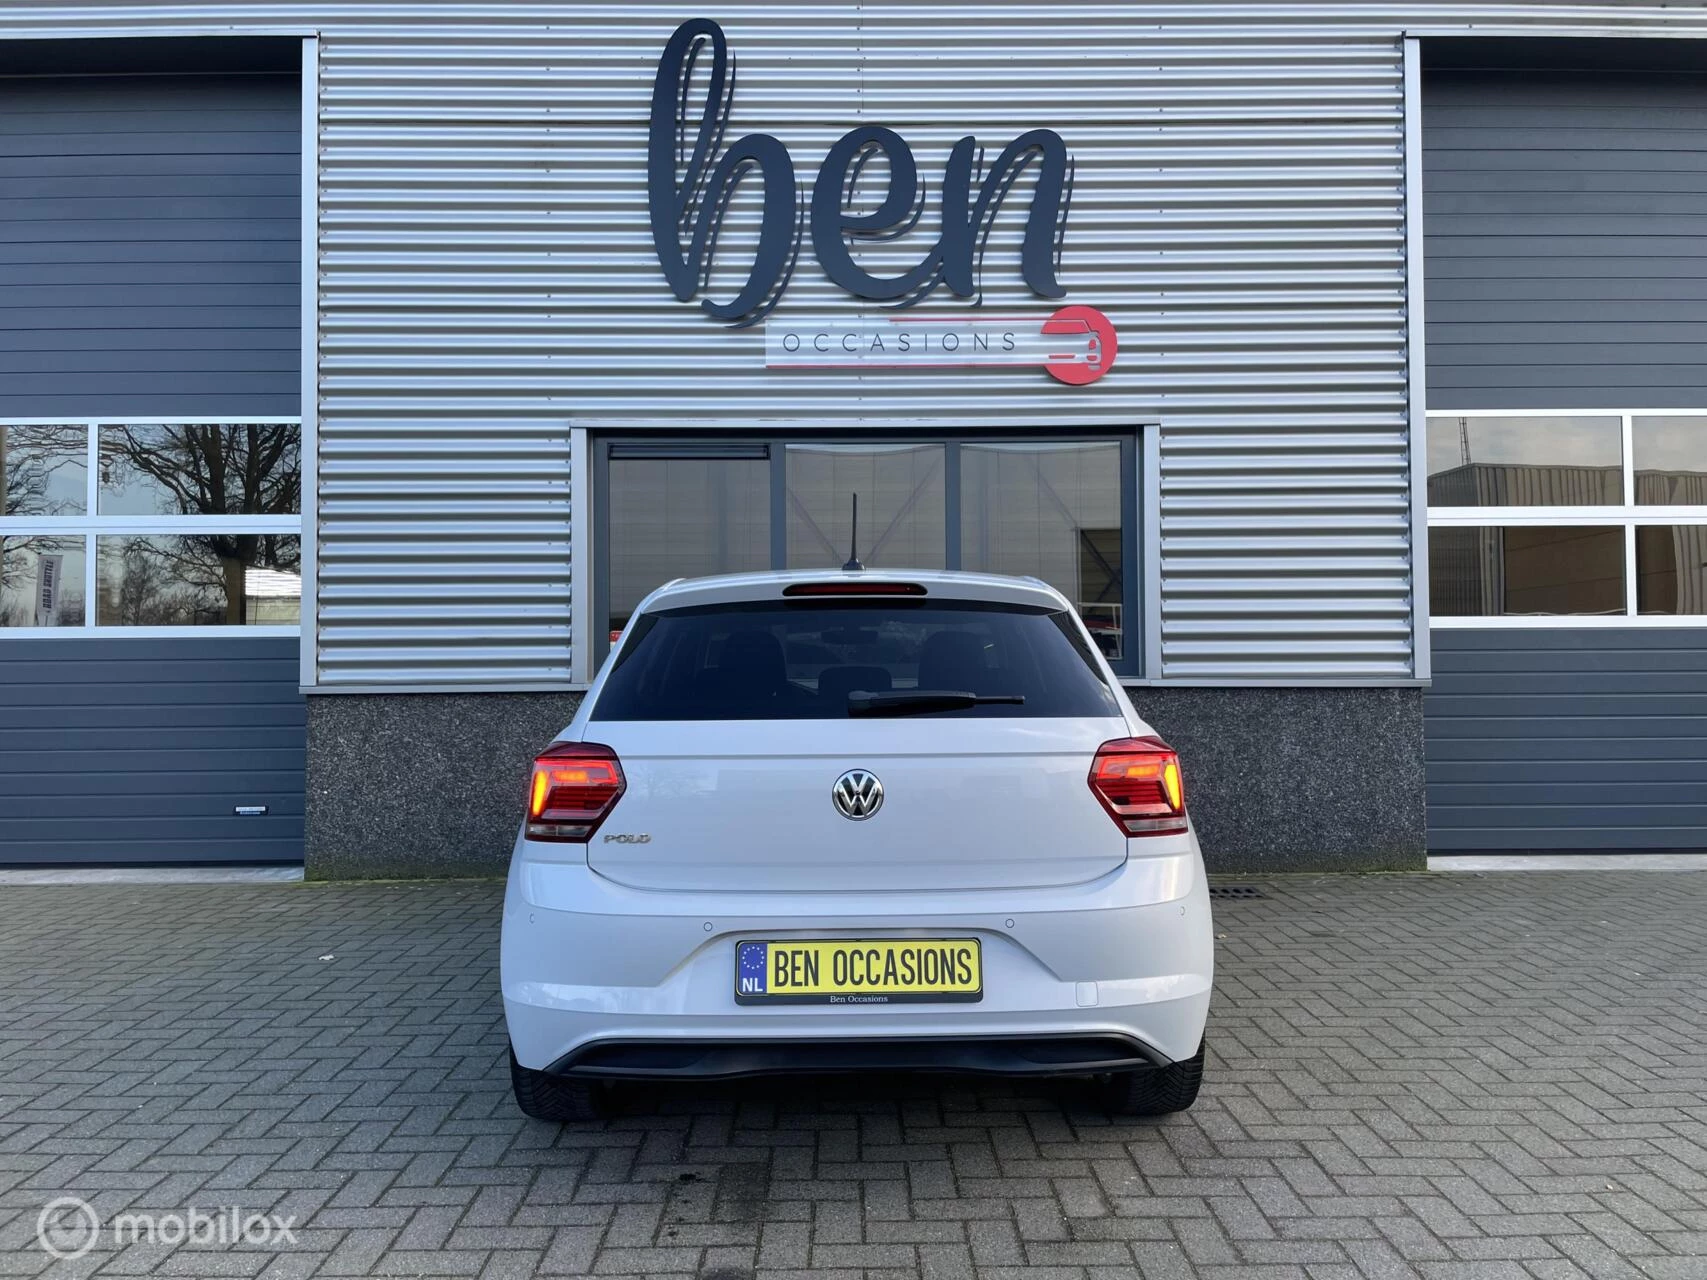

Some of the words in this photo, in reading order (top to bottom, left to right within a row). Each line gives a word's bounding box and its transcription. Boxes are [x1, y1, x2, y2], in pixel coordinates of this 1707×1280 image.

[648, 17, 1072, 321] ben
[782, 332, 1017, 352] OCCASIONS
[603, 834, 652, 844] POLO
[774, 949, 820, 987] BEN
[833, 948, 972, 986] OCCASIONS
[742, 977, 763, 992] NL
[829, 995, 846, 1003] Ben
[847, 994, 889, 1003] Occasions
